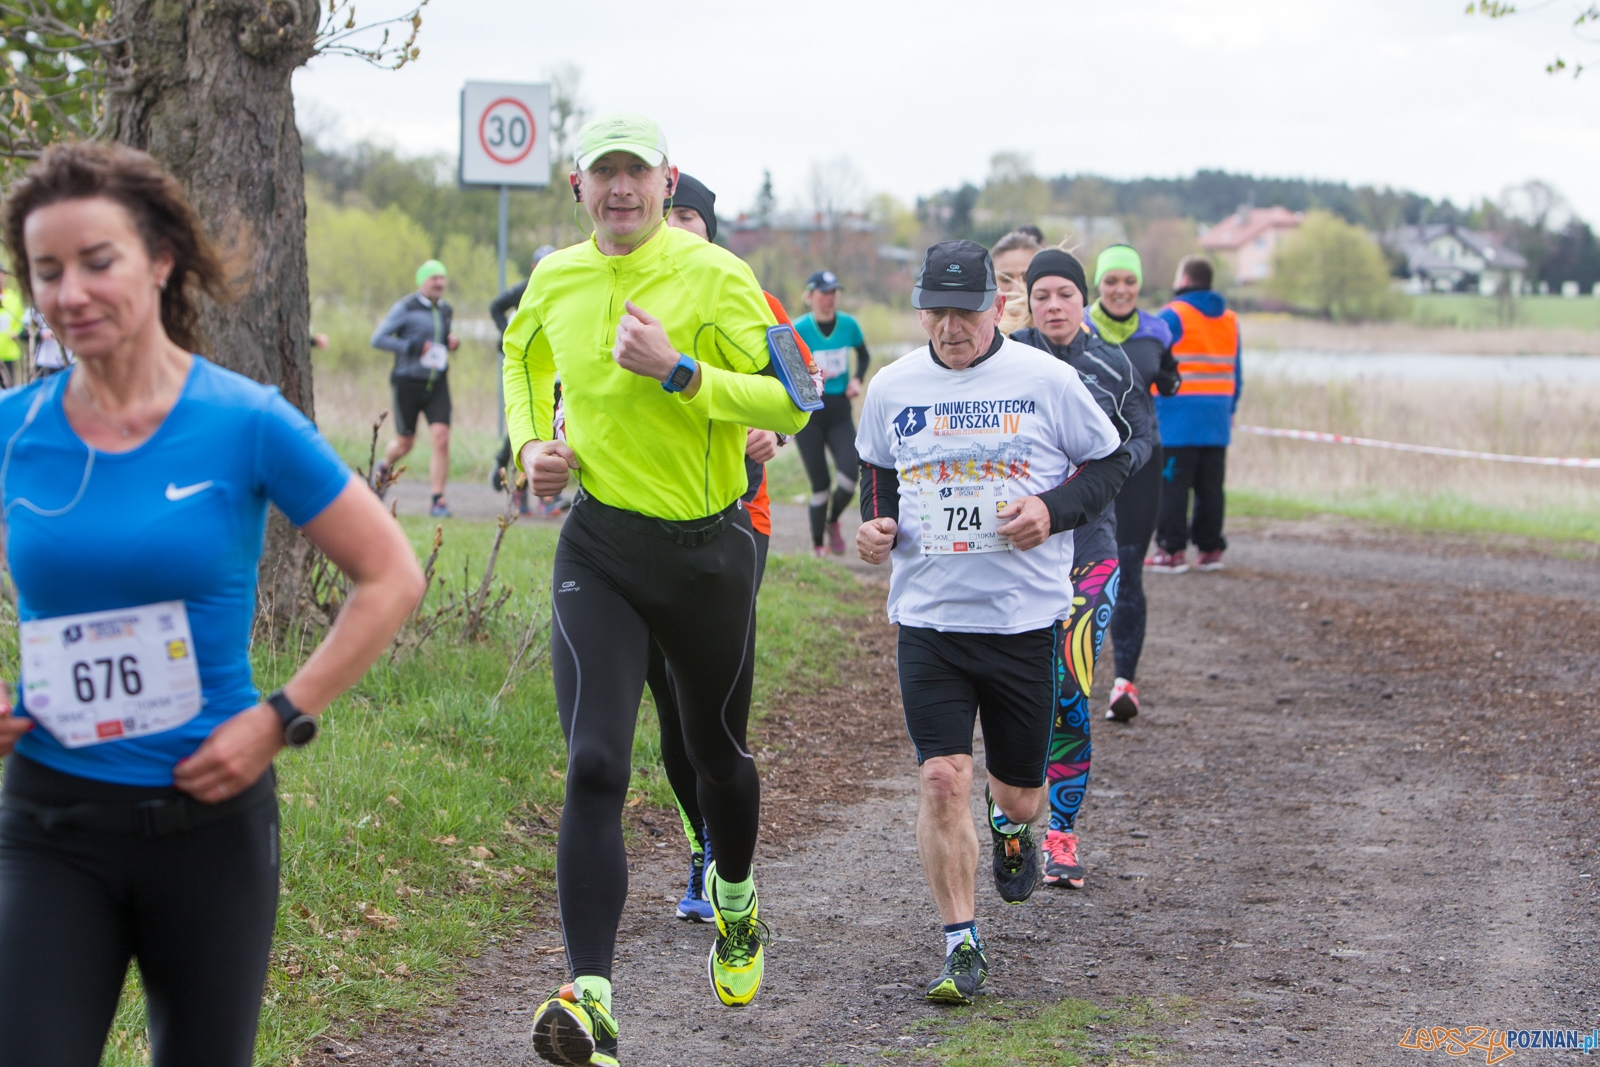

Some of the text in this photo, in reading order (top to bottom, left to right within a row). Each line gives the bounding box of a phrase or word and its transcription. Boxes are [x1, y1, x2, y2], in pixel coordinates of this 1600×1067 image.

[488, 115, 527, 149] 30
[934, 400, 1036, 416] UNIWERSYTECKA
[933, 413, 1021, 435] ZADYSZKA IV
[943, 506, 982, 531] 724
[73, 655, 143, 703] 676
